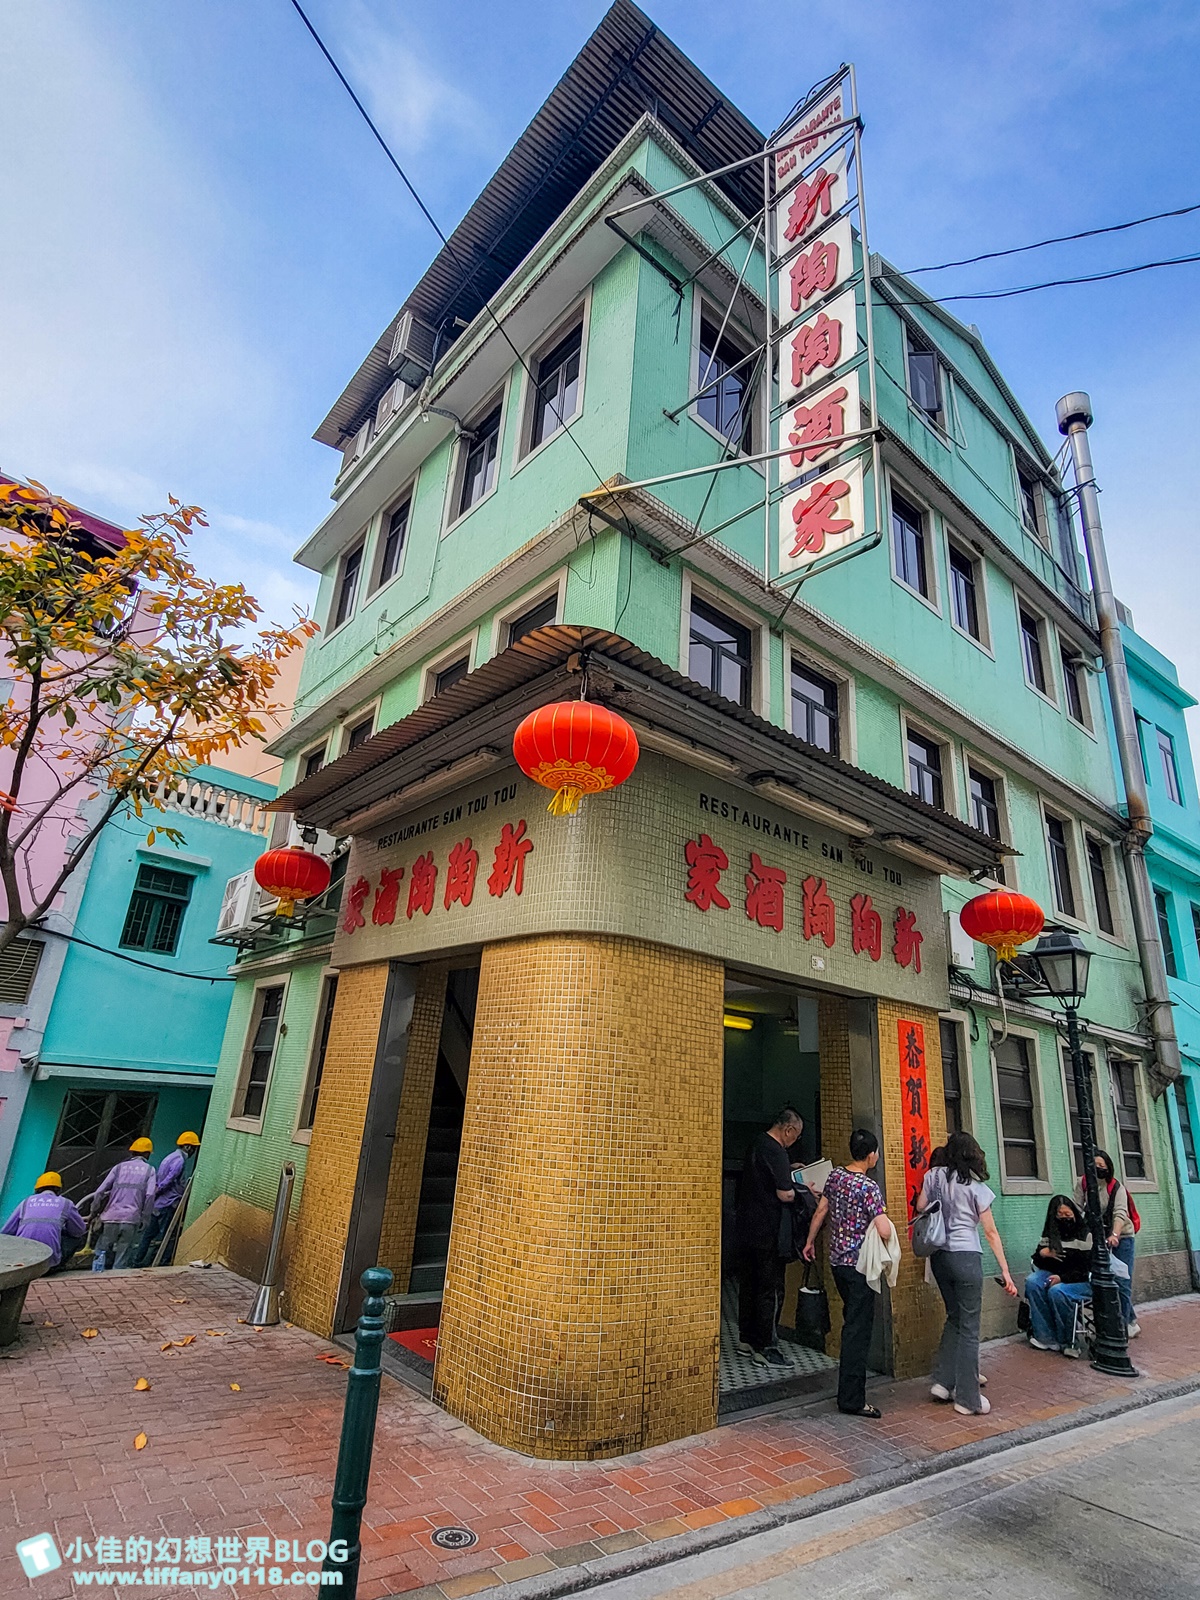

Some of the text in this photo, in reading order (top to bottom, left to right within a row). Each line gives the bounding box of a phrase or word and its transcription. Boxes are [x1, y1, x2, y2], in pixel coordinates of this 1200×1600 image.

[776, 95, 841, 162] RAURANTE
[777, 154, 796, 179] SAN
[784, 167, 854, 558] 新陶陶酒家
[377, 783, 517, 850] RESTAURANTE SAN TOU TOU
[700, 793, 809, 849] RESTAURANTE
[821, 842, 843, 863] SAN
[883, 866, 902, 885] TOU
